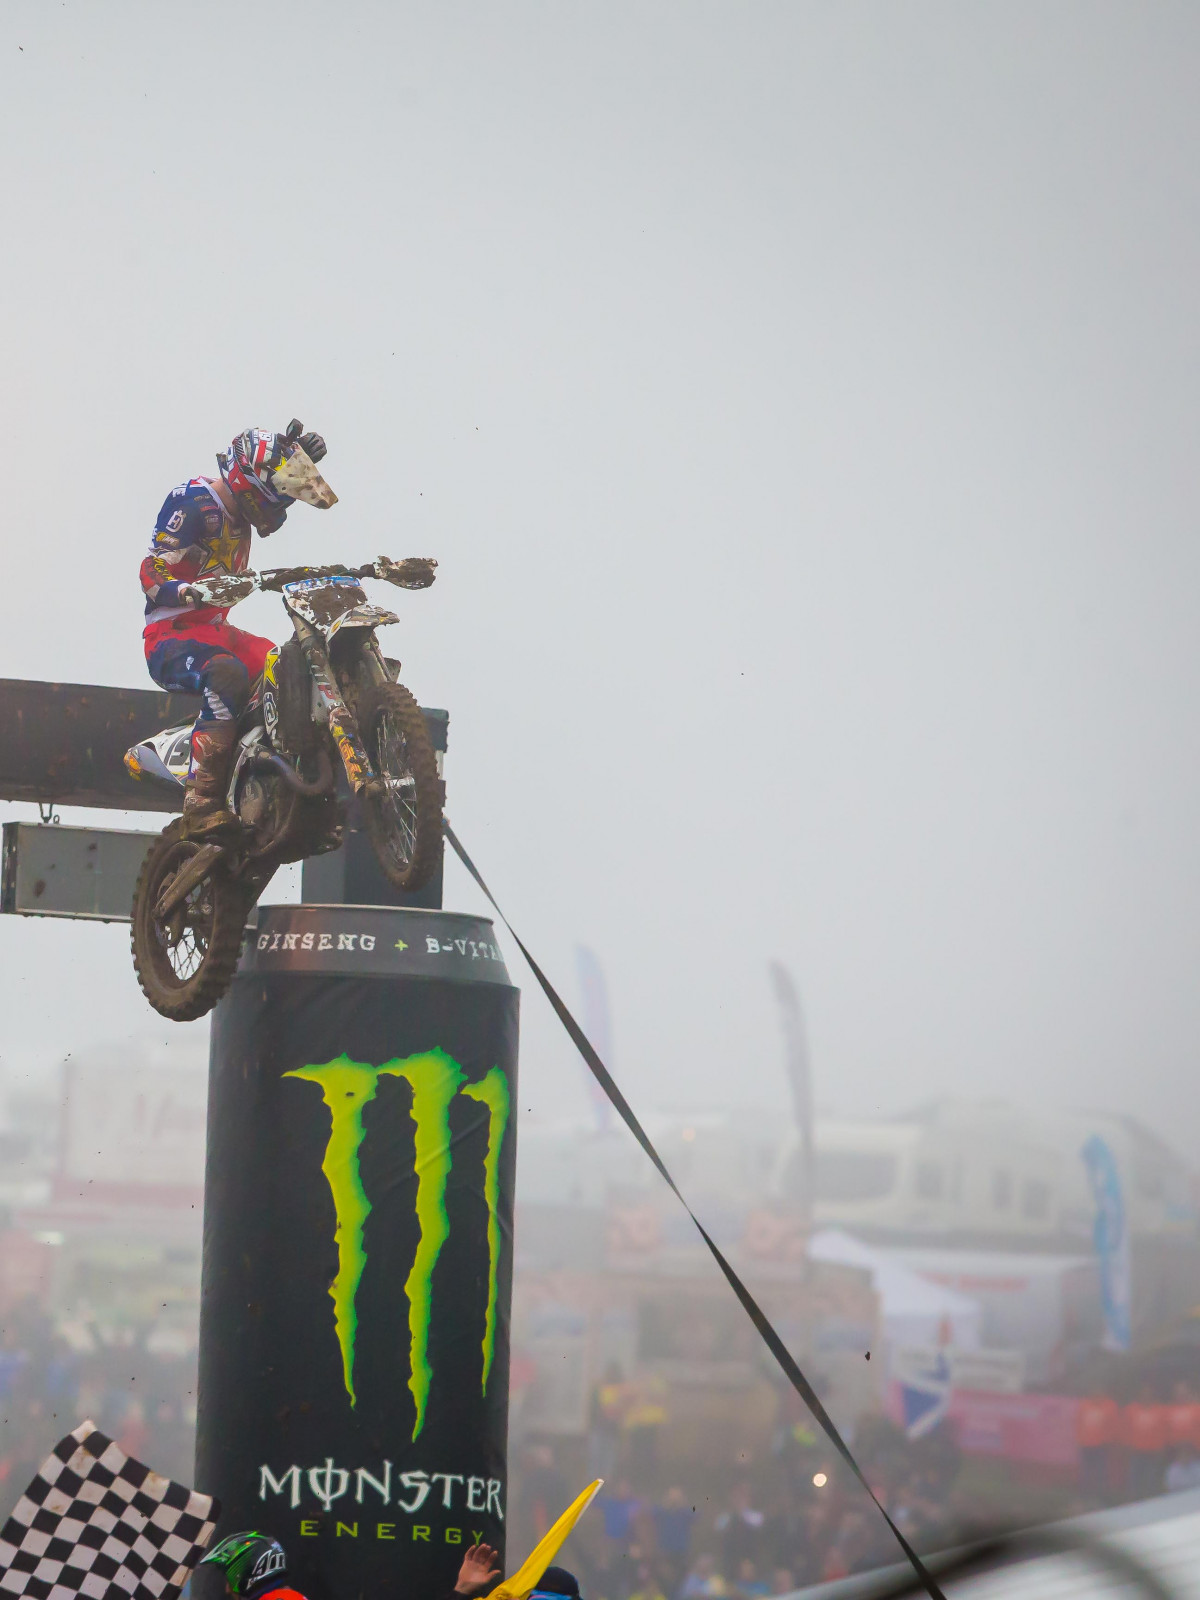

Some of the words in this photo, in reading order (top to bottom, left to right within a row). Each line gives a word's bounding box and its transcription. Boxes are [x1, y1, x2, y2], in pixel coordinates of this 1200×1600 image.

[257, 931, 377, 952] GINSENG
[258, 1457, 504, 1521] MONSTER
[300, 1519, 484, 1547] ENERGY
